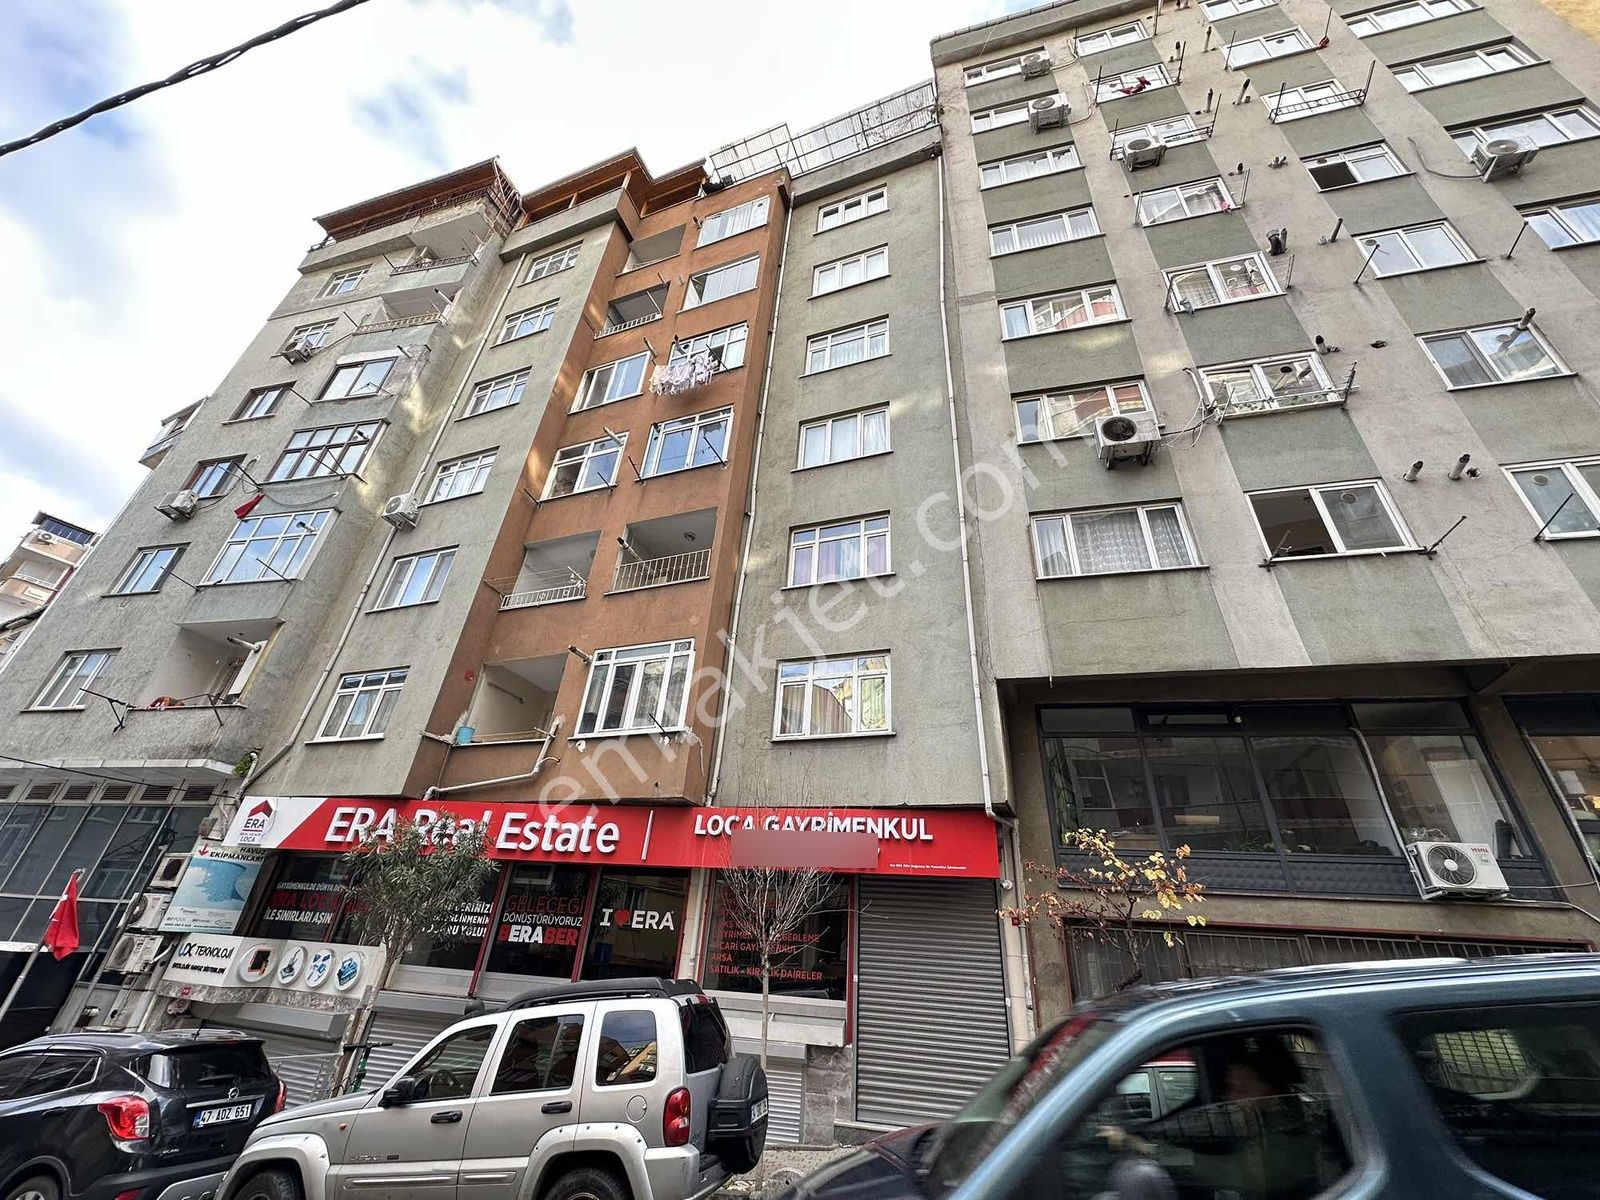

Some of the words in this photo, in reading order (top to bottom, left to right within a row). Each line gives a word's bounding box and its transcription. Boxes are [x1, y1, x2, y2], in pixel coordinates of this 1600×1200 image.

[244, 818, 266, 829] ERA
[324, 806, 396, 843] ERA
[495, 811, 620, 853] Estate
[765, 811, 934, 841] GAYRİMENKUL
[240, 847, 266, 855] HAVUZ
[263, 908, 277, 920] İLE
[311, 911, 334, 925] AŞIN
[600, 908, 614, 926] I
[626, 910, 675, 931] ERA
[498, 924, 579, 947] BERABER
[201, 1110, 213, 1123] 47
[235, 1105, 250, 1118] 651
